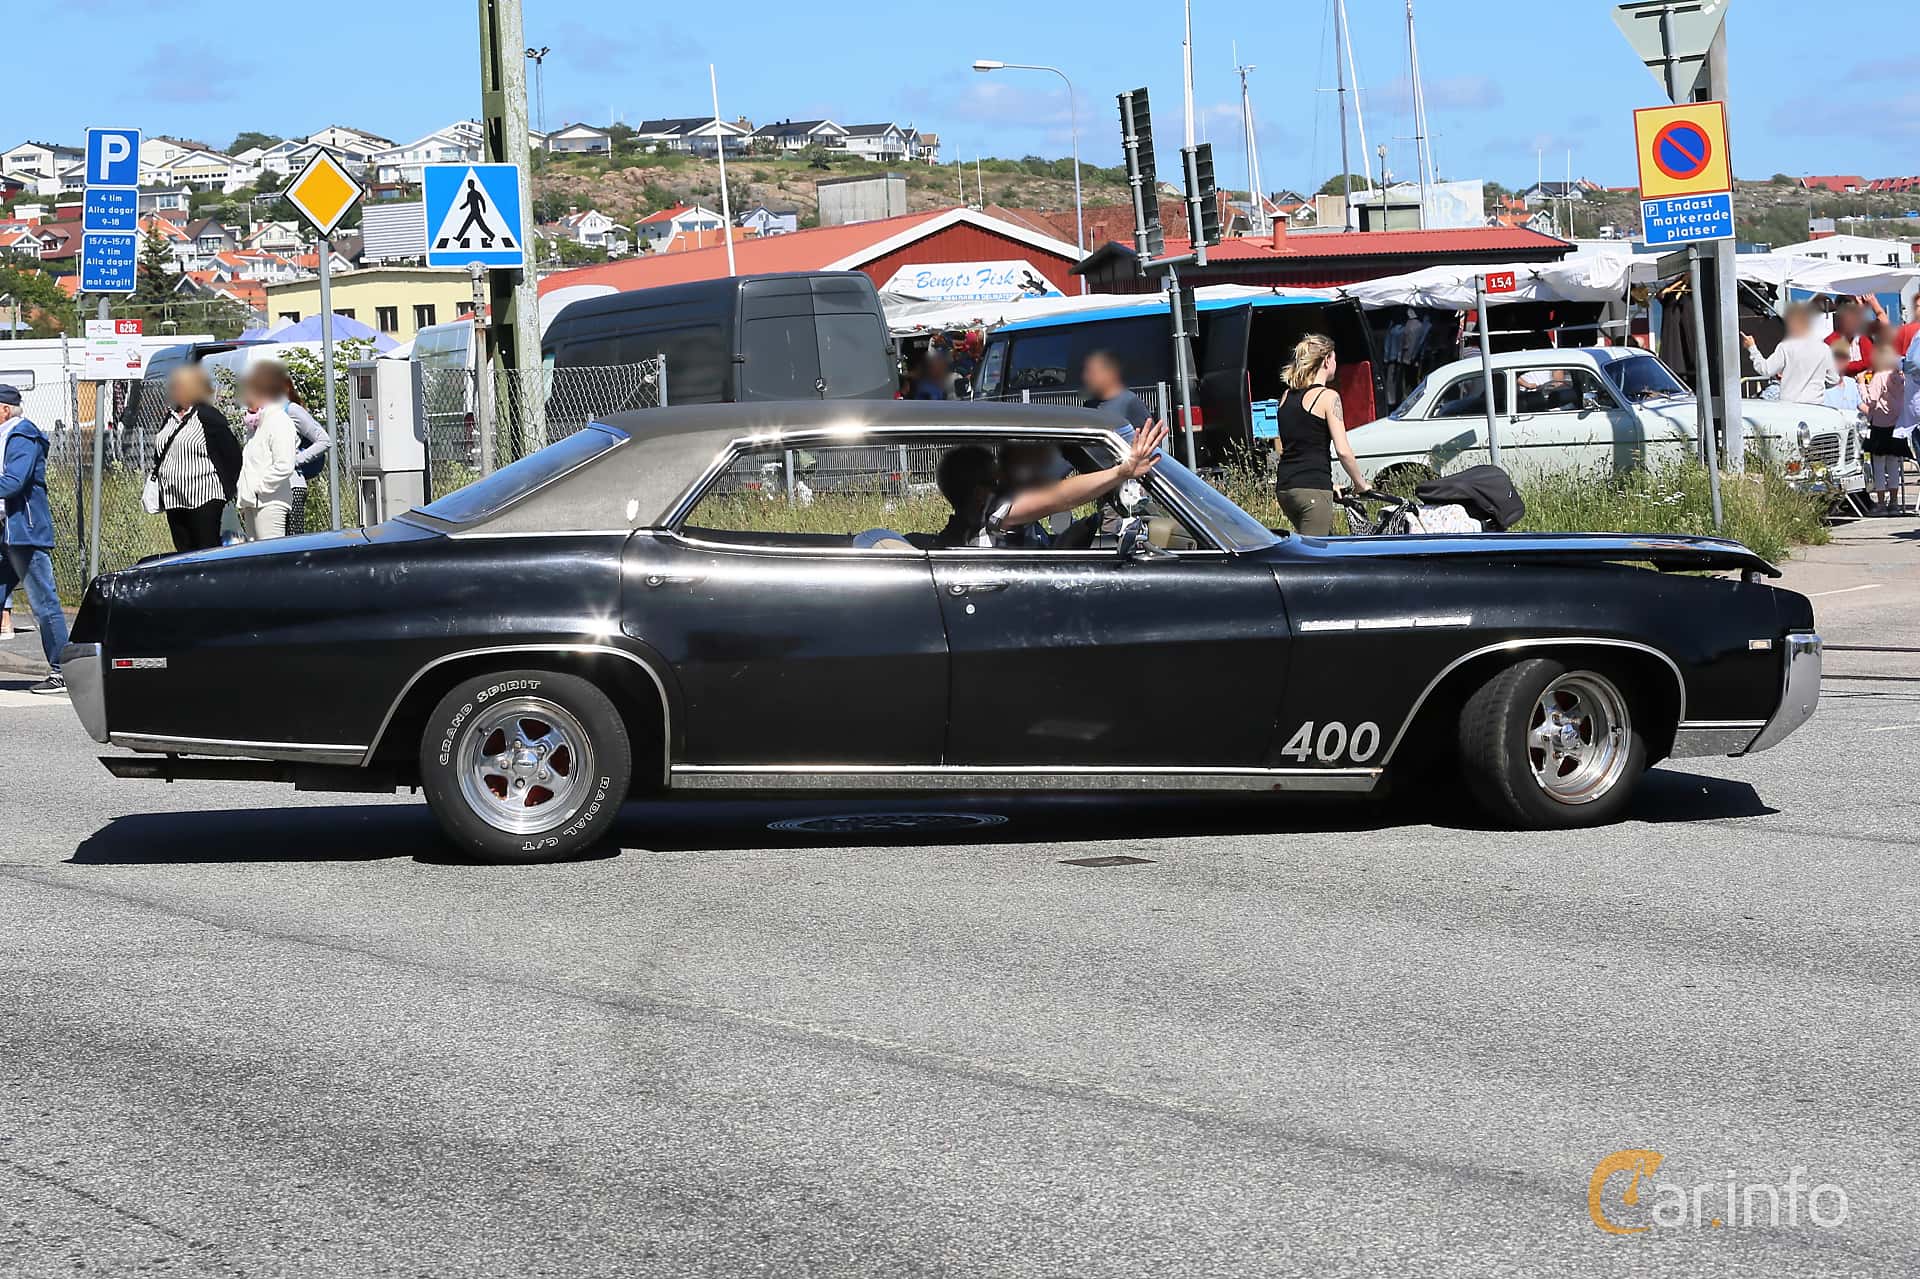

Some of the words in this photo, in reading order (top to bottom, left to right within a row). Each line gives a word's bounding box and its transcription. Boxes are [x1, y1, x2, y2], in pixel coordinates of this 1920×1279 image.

[100, 135, 130, 180] P
[109, 206, 134, 215] dagar
[1667, 198, 1713, 212] Endast
[102, 218, 120, 226] 9-18
[1653, 209, 1729, 226] markerade
[1667, 225, 1717, 241] platser
[89, 237, 131, 245] 15/6-15/8
[107, 258, 132, 267] dagar
[100, 268, 118, 276] 9-18
[105, 279, 131, 287] avgift
[916, 272, 970, 291] Bengts
[976, 268, 1016, 289] Fisk
[1491, 276, 1512, 289] 15,4
[120, 323, 137, 333] 6292
[439, 703, 473, 766] GRAND
[476, 680, 541, 704] SPIRIT
[1281, 721, 1380, 762] 400
[563, 776, 610, 836] RADIAL
